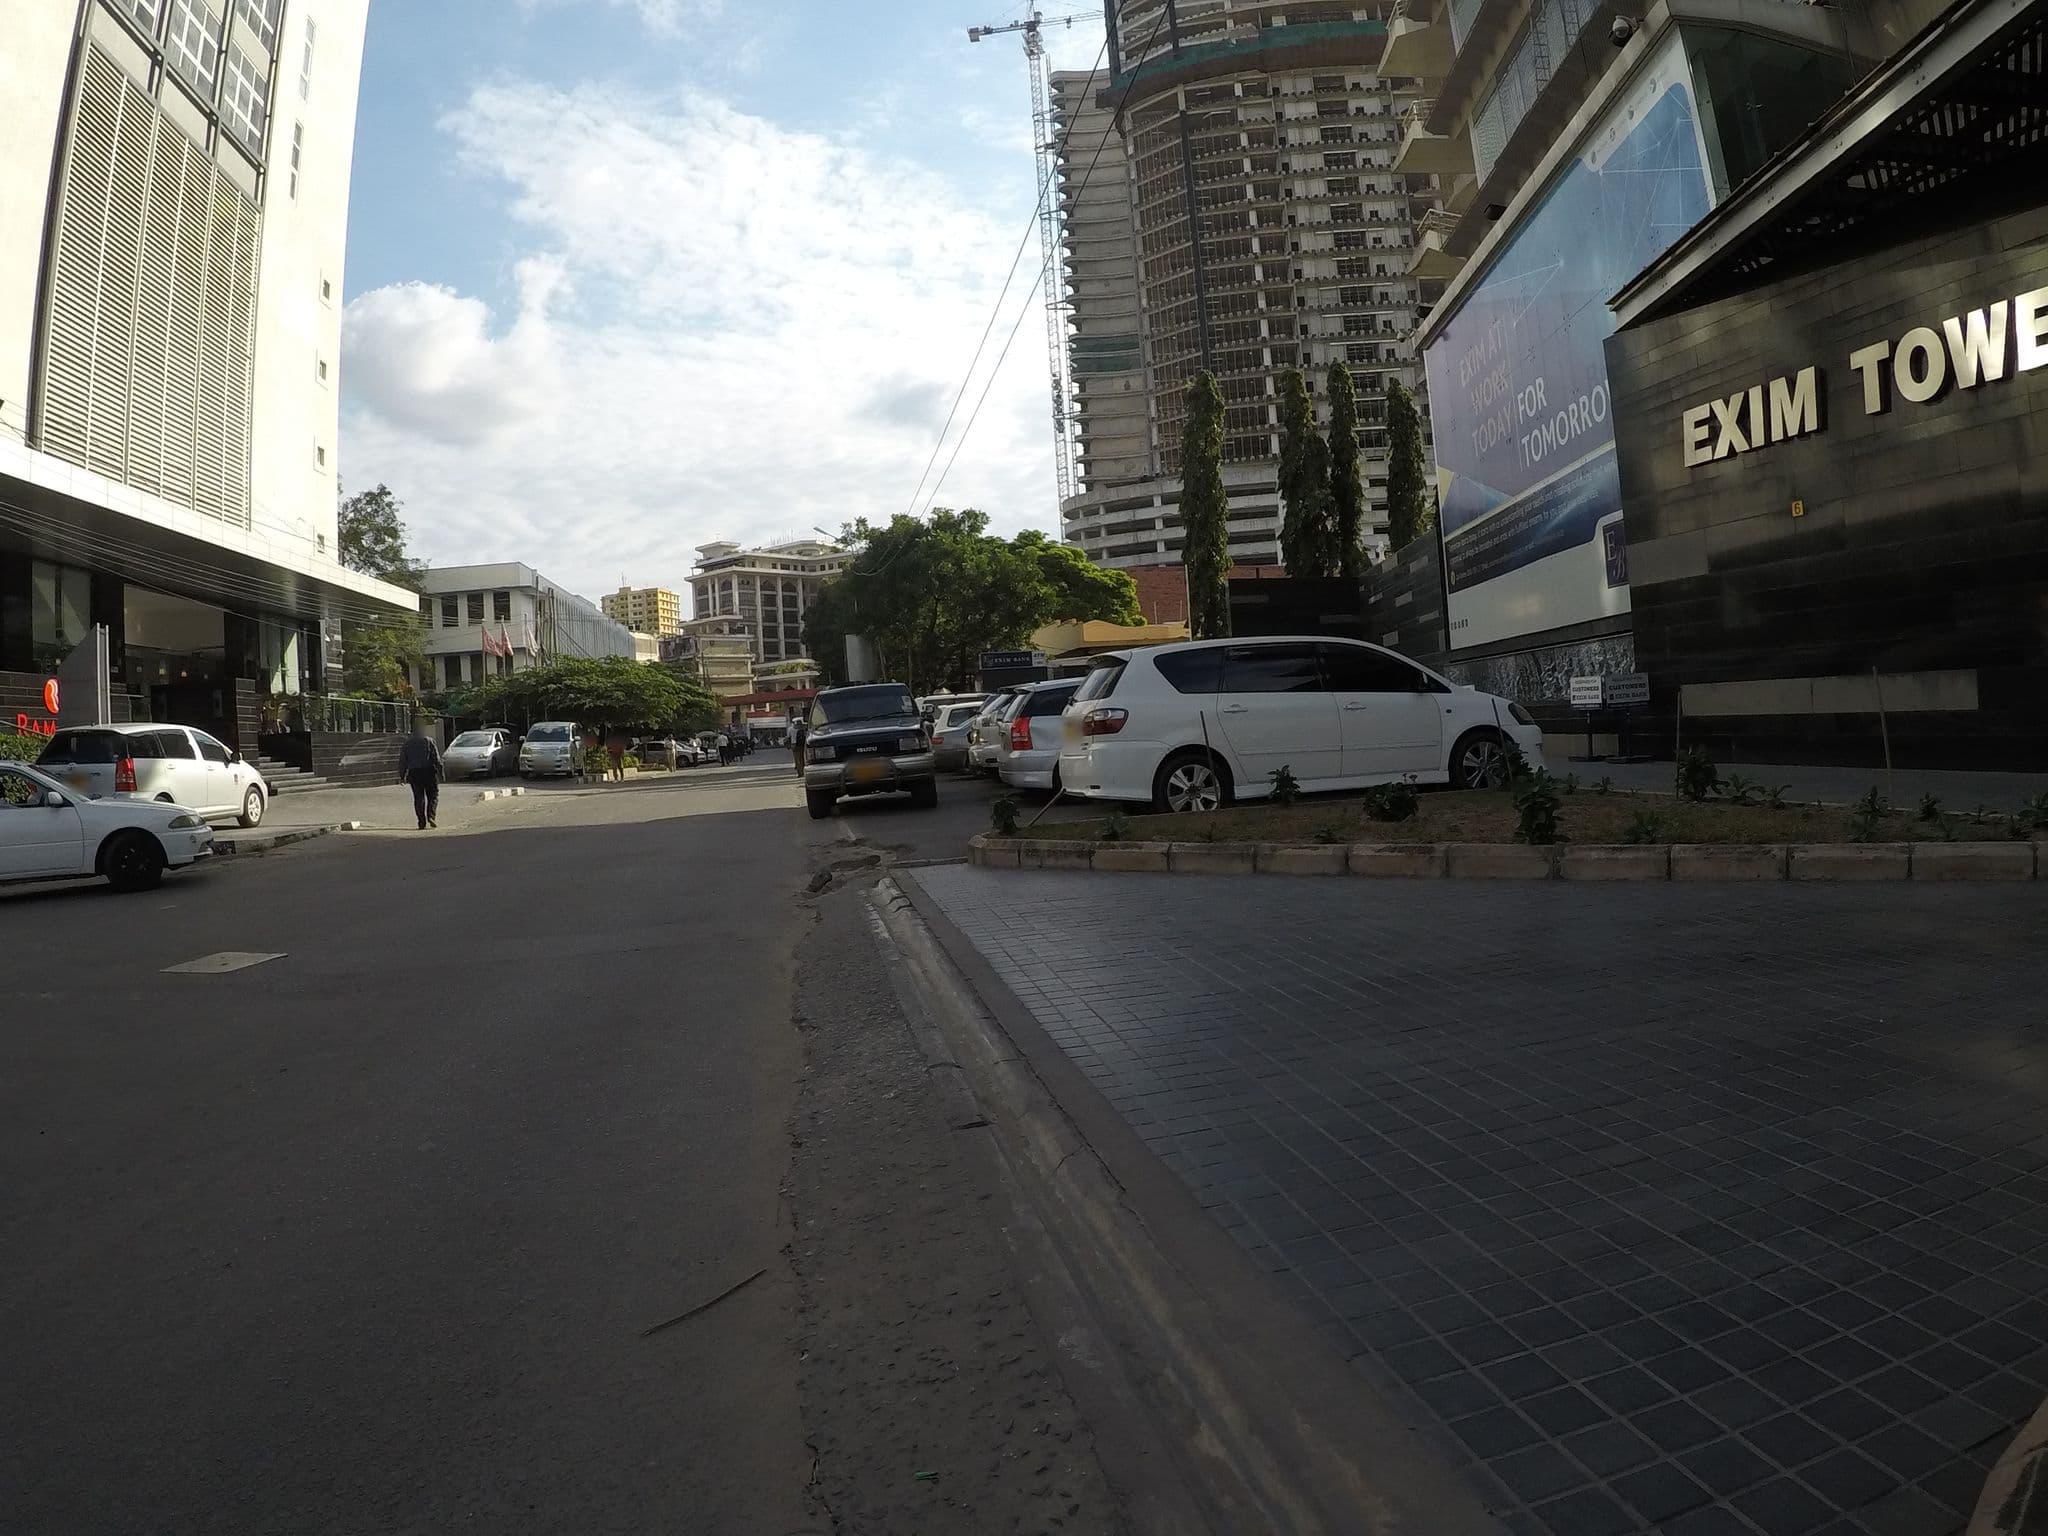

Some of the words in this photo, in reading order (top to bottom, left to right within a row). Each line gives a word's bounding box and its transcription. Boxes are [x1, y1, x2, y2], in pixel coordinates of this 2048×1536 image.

[1460, 340, 1487, 388] EXIM
[1470, 360, 1511, 416] WORK
[1517, 376, 1548, 425] FOR
[1521, 379, 1611, 468] TOMORRO
[1682, 366, 1819, 468] EXIM
[1472, 401, 1513, 457] TODAY
[1013, 655, 1030, 663] BANK
